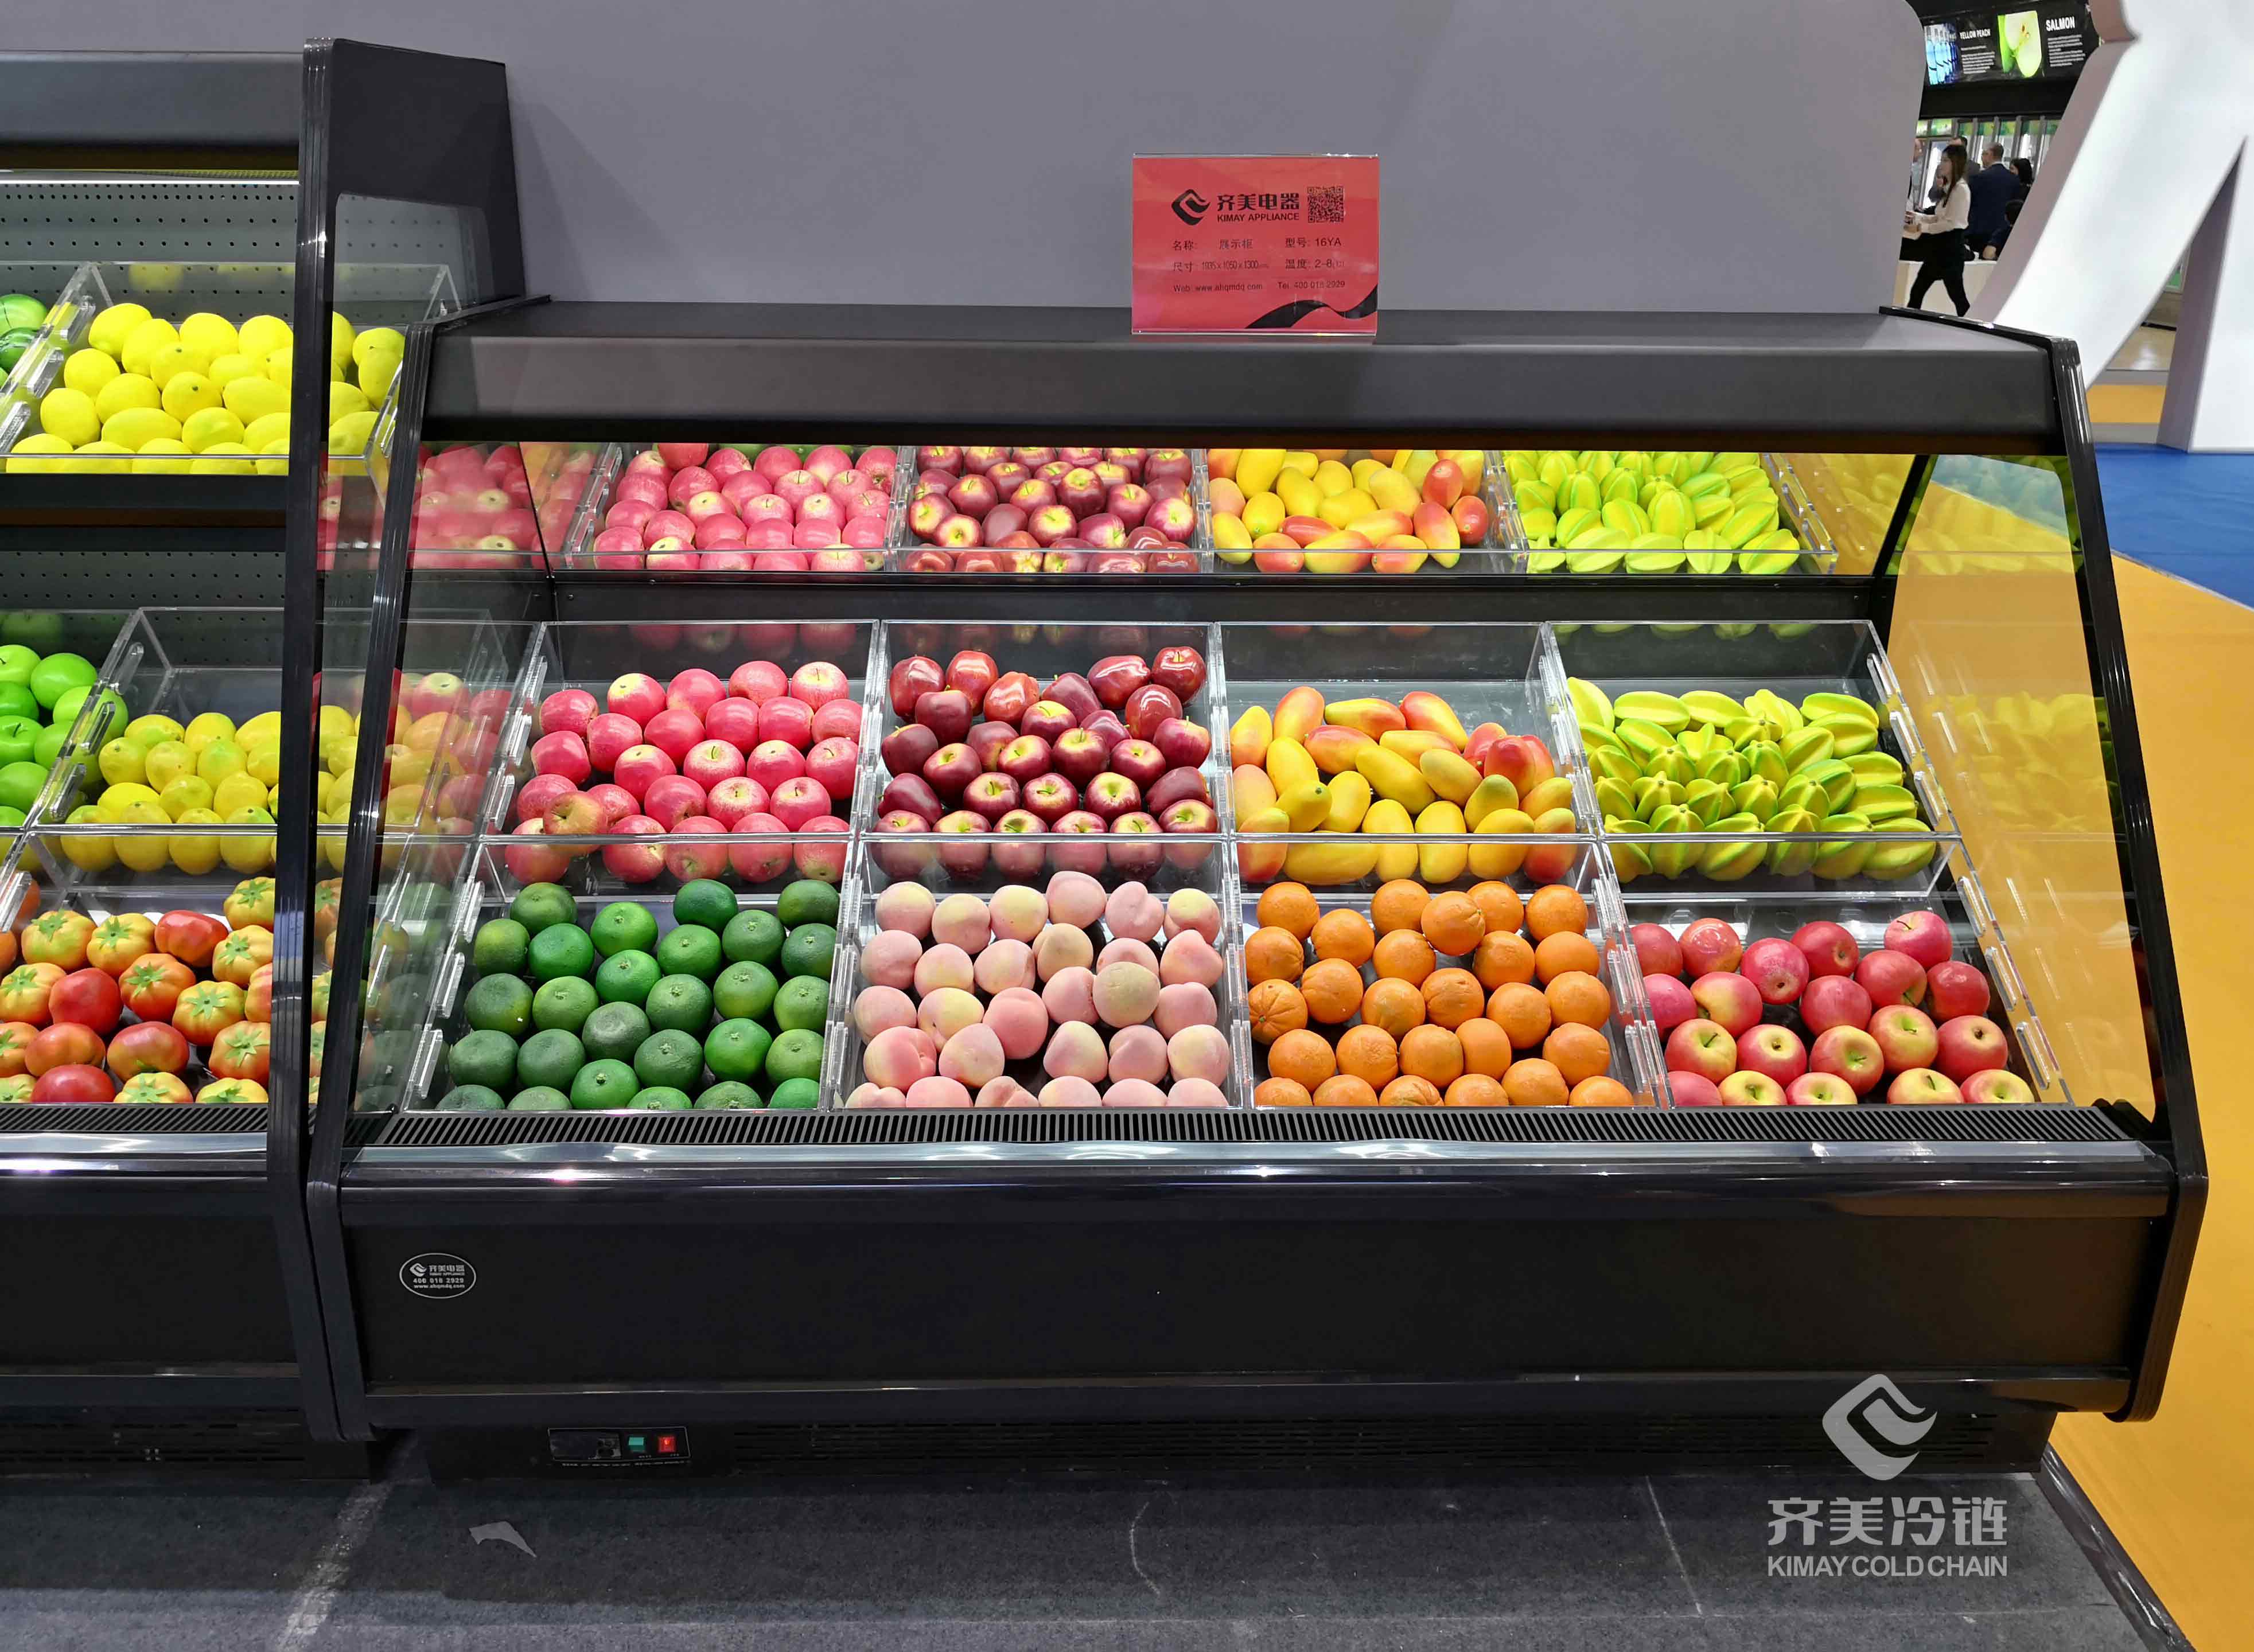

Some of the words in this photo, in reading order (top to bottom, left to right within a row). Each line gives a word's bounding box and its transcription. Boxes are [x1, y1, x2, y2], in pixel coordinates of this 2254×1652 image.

[2046, 16, 2075, 32] SALMON
[1959, 30, 1976, 40] YELLOW
[1977, 29, 1991, 37] PEACH
[1217, 192, 1299, 212] 齐美电器
[1217, 214, 1245, 223] KIMAY
[1248, 212, 1299, 221] APPLIANCE
[1315, 237, 1342, 247] 16YA
